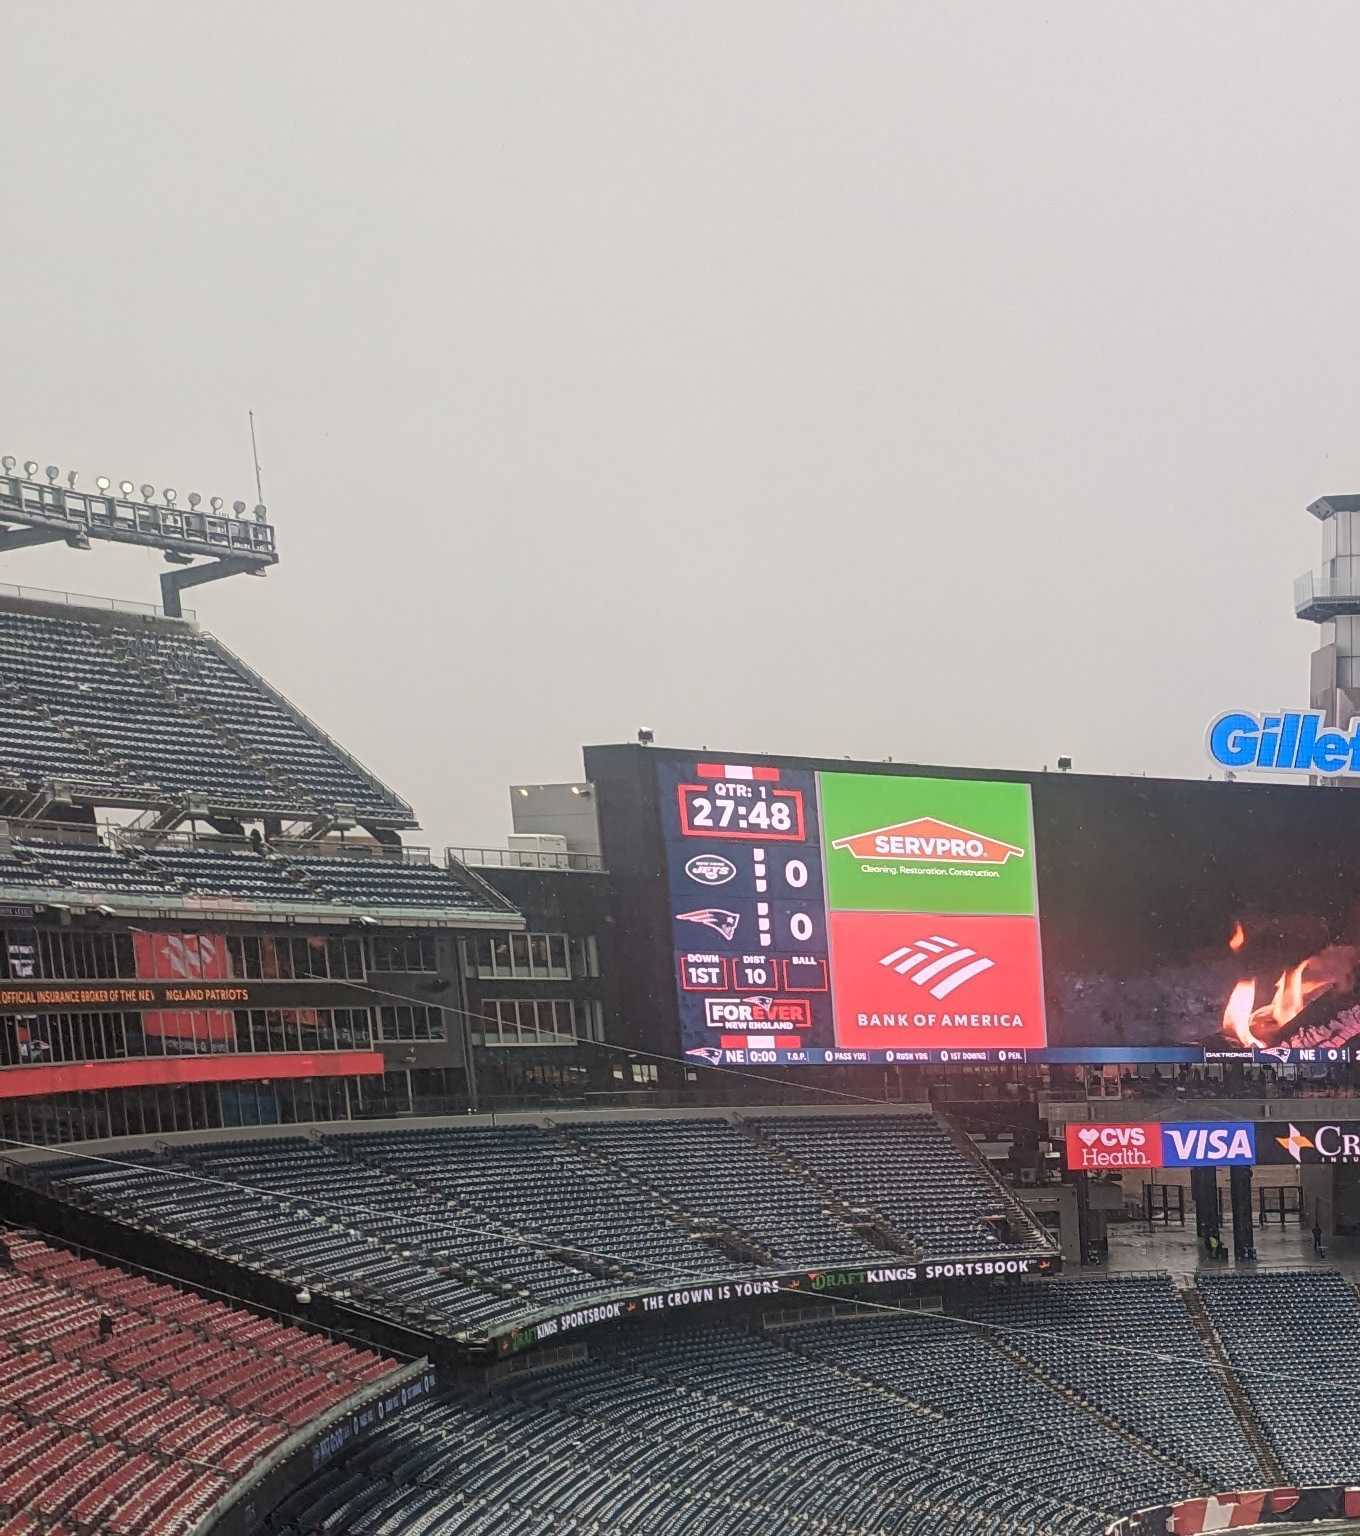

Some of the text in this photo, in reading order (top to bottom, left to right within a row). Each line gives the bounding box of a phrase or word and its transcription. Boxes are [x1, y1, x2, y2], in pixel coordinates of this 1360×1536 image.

[714, 783, 767, 799] QTR: 1
[692, 798, 791, 831] 27:48
[785, 859, 808, 888] 0
[790, 912, 813, 941] 0
[687, 953, 719, 964] DOWN
[743, 955, 766, 965] DIST
[792, 955, 817, 965] BALL
[689, 967, 720, 984] 1ST
[745, 968, 767, 985] 10
[712, 1005, 804, 1021] FOREVER
[857, 1013, 1024, 1028] BANK OF AMERICA
[724, 1020, 794, 1030] NEW ENGLAND
[726, 1050, 777, 1063] NE 0:00
[1299, 1050, 1316, 1061] NE
[1327, 1050, 1338, 1061] 0
[1100, 1128, 1145, 1146] CVS
[1164, 1129, 1252, 1160] VISA
[643, 1280, 780, 1311] THE CROWN IS YOURS
[560, 1303, 622, 1330] SPORTSBOOK
